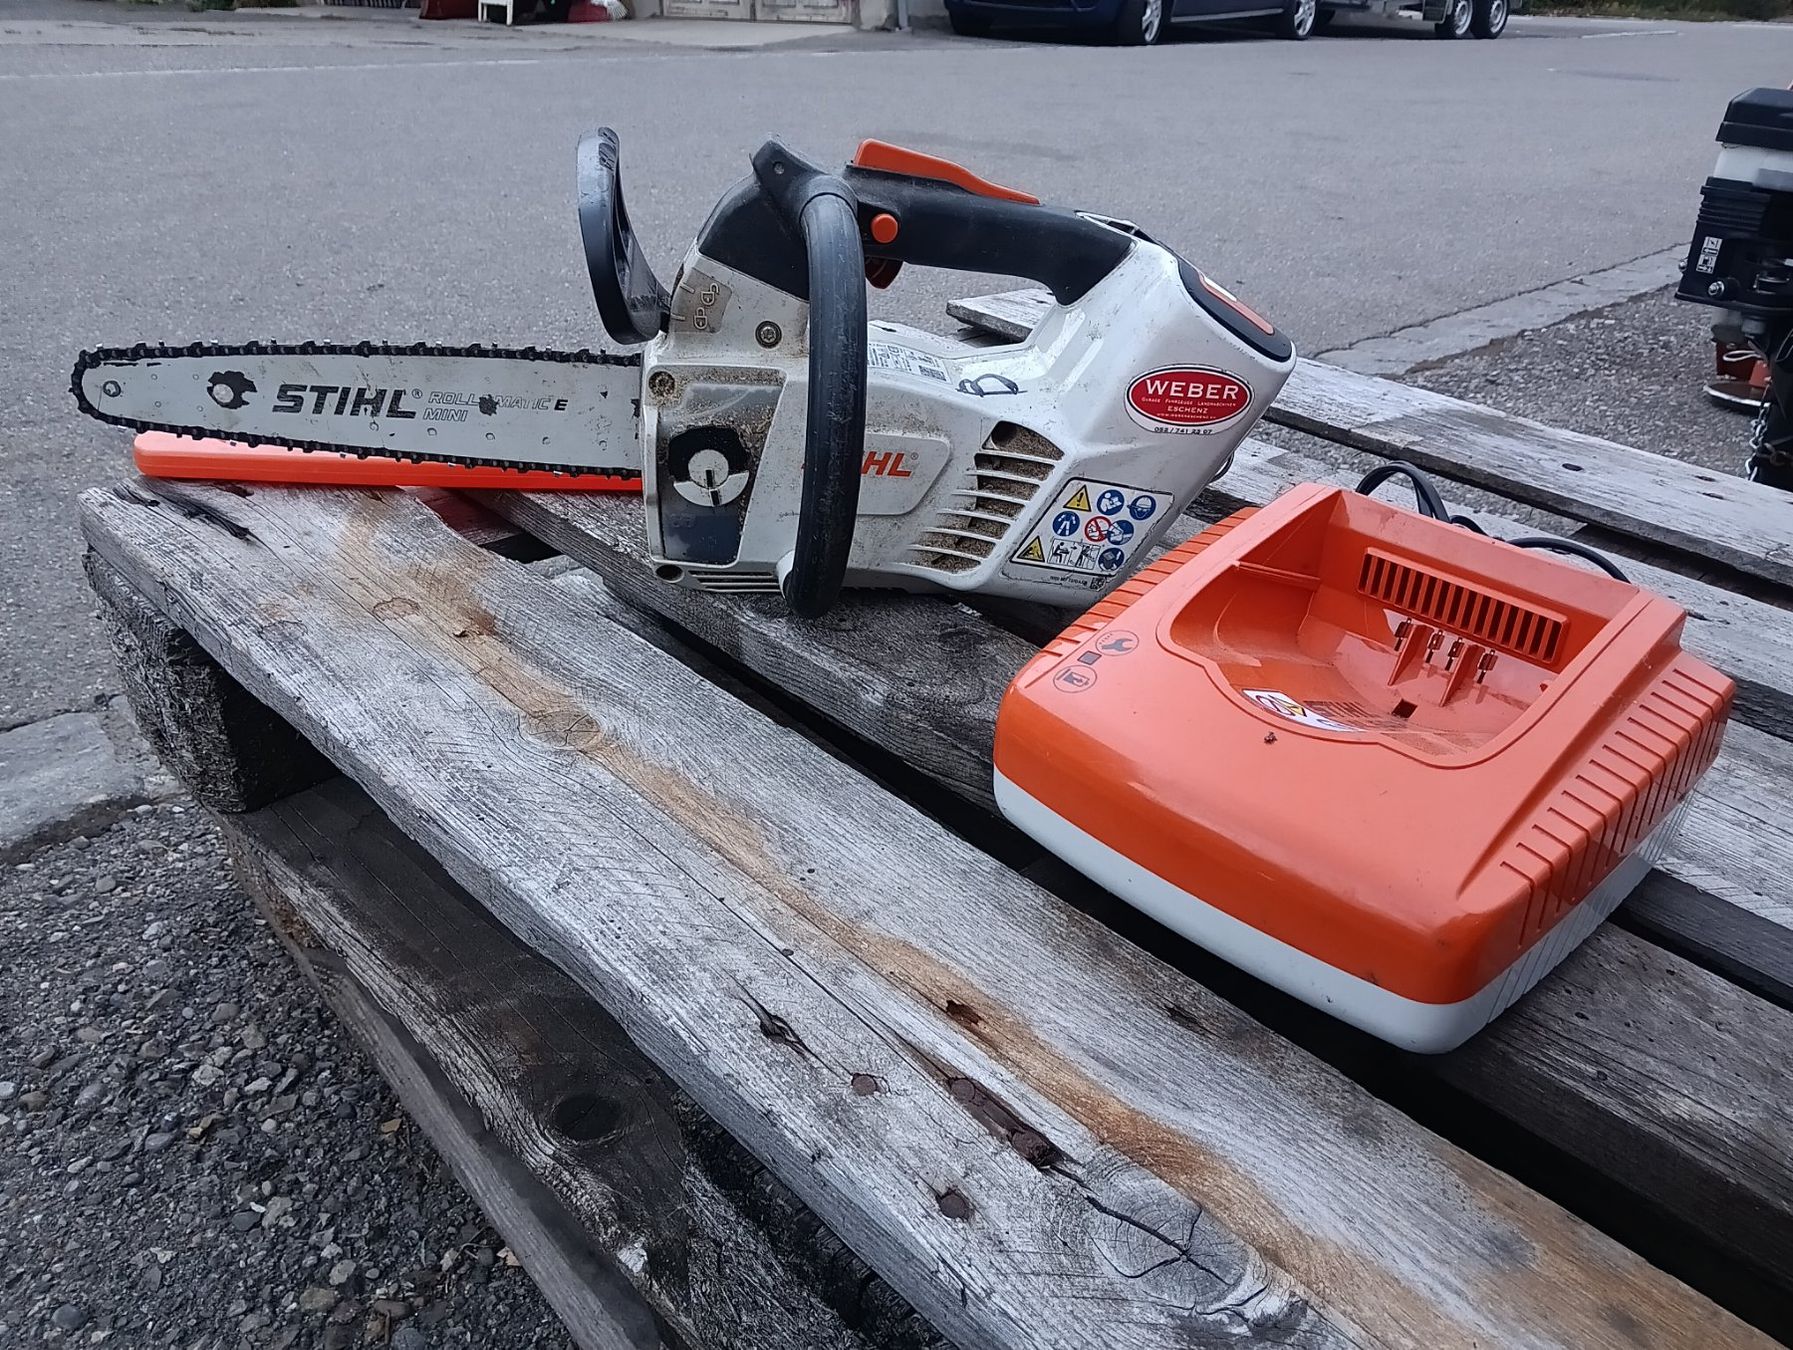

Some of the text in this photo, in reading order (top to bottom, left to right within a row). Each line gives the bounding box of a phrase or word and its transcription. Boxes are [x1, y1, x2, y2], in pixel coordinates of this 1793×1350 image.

[1145, 379, 1239, 400] WEBER
[423, 407, 469, 422] MINI
[1167, 406, 1208, 414] ESCHENZ
